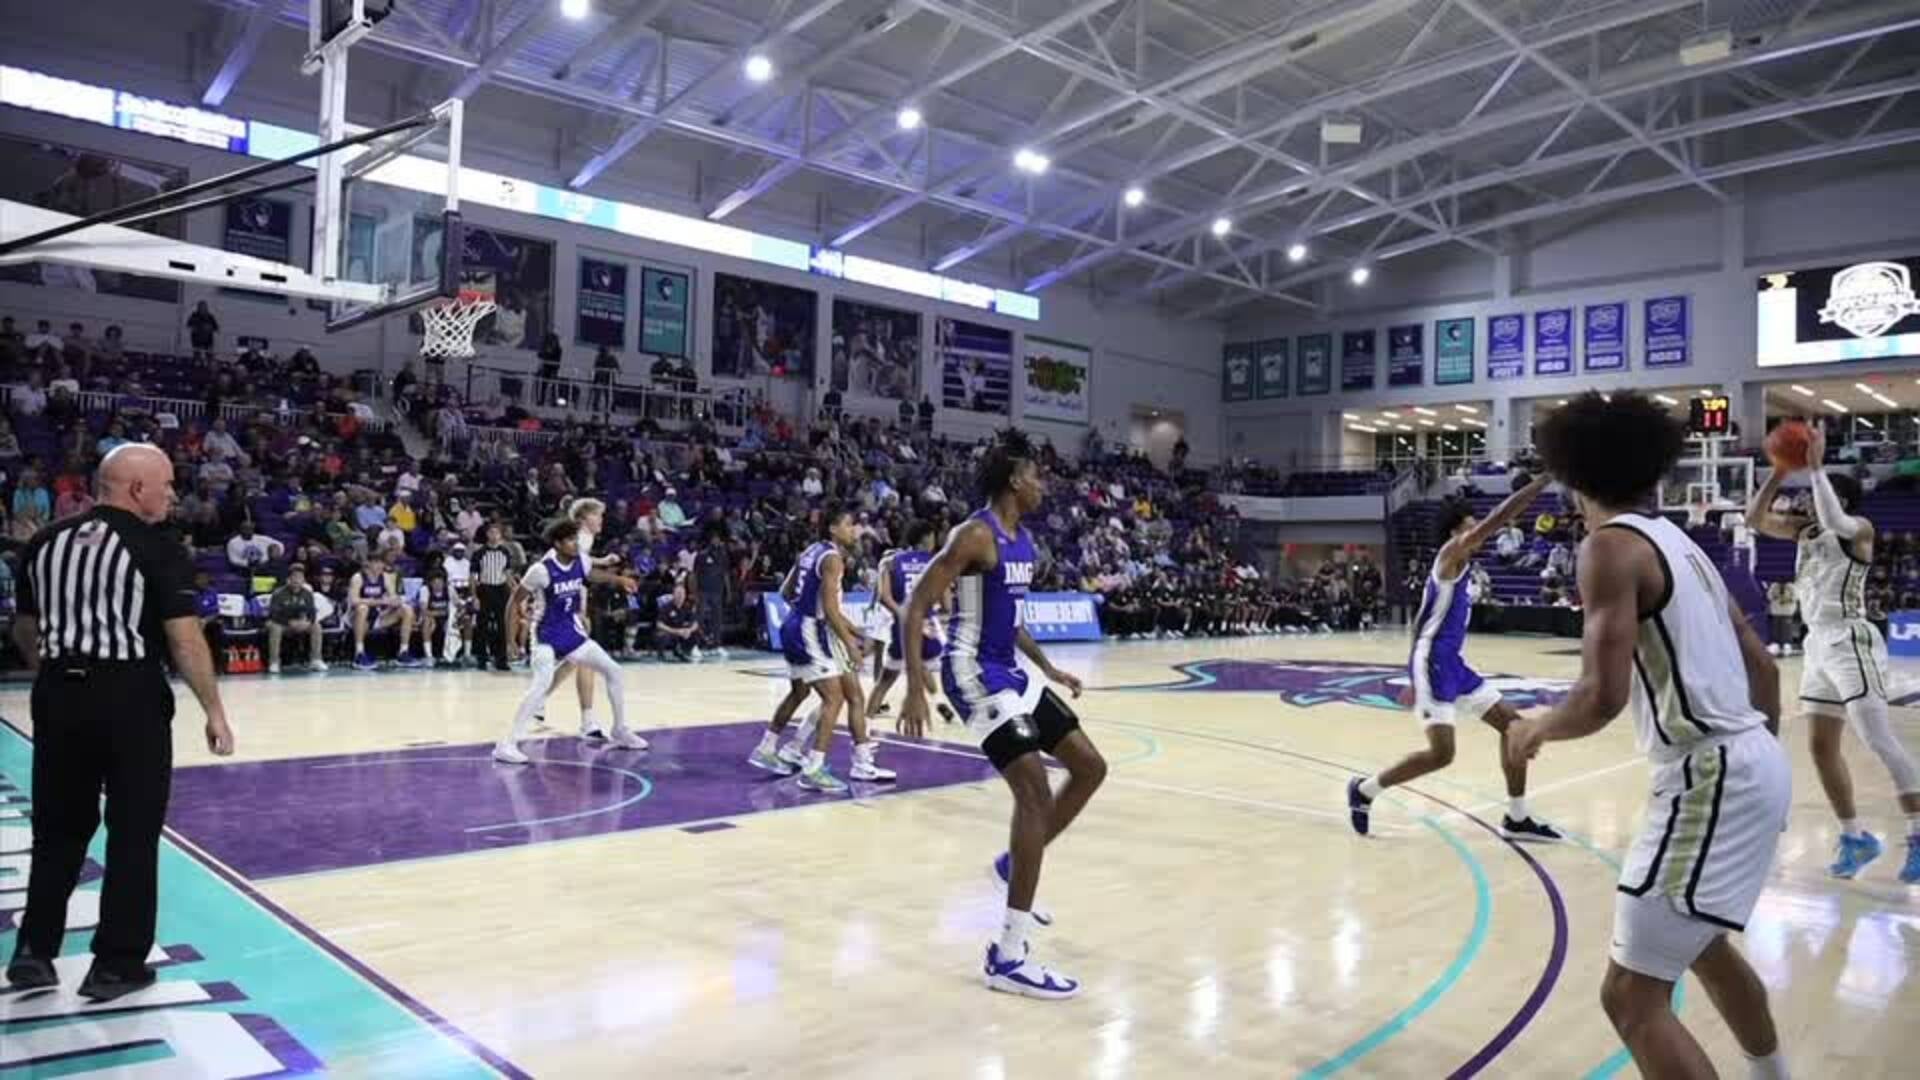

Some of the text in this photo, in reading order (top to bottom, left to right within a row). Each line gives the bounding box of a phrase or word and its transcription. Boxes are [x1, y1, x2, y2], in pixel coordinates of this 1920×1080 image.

[1003, 562, 1034, 585] IMG
[553, 578, 583, 594] IMG
[563, 597, 573, 612] 2
